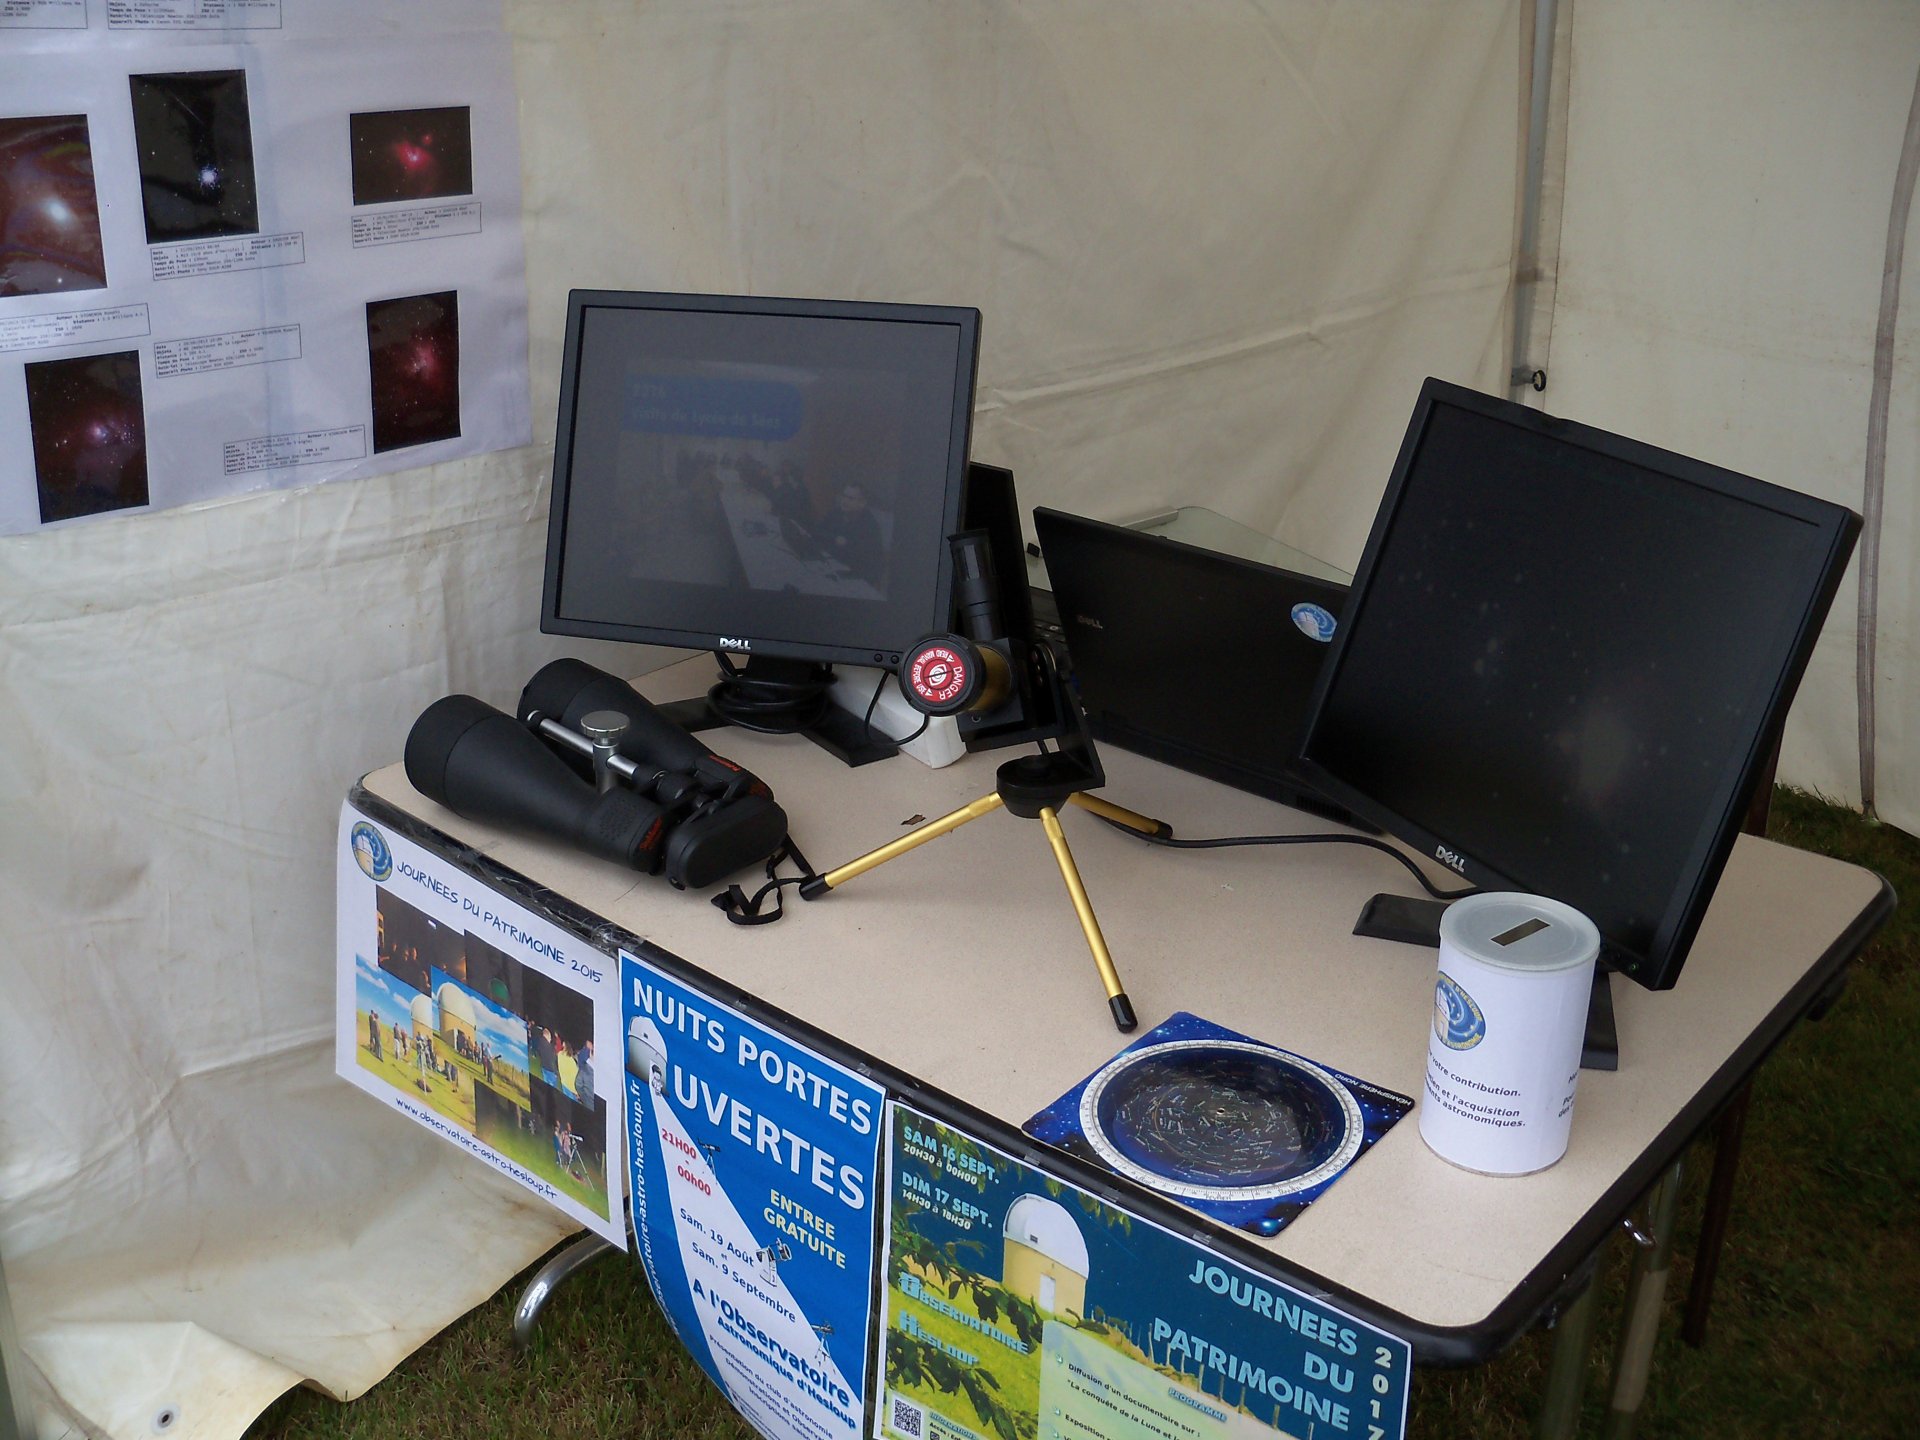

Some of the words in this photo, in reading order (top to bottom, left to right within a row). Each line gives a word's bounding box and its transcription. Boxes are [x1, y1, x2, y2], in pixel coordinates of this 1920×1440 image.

[720, 637, 751, 650] DELL
[938, 665, 964, 700] DANGER
[1435, 845, 1465, 873] DELL
[396, 861, 459, 904] JOURNEES
[463, 899, 480, 916] DU
[484, 911, 565, 965] PATRIMOINE
[571, 959, 604, 983] 2015
[633, 977, 726, 1054] NUITS
[738, 1034, 872, 1136] PORTES
[1441, 1089, 1451, 1099] et
[1452, 1094, 1520, 1118] l'acquisition
[1450, 1072, 1521, 1097] contribution.
[673, 1064, 866, 1211] UVERTES
[1442, 1101, 1526, 1128] astronomiques.
[661, 1128, 697, 1160] 21H00
[903, 1125, 938, 1153] SAM
[941, 1142, 956, 1162] 16
[959, 1153, 1000, 1185] SEPT.
[903, 1142, 936, 1164] 20H30
[936, 1156, 943, 1168] à
[946, 1163, 978, 1186] 00H00
[677, 1166, 712, 1197] 00h00
[902, 1171, 931, 1197] DIM
[935, 1187, 950, 1205] 17
[952, 1197, 993, 1229] SEPT.
[770, 1188, 836, 1241] ENTREE
[902, 1189, 931, 1210] 14H30
[932, 1203, 939, 1214] à
[942, 1208, 972, 1231] 18H30
[680, 1207, 707, 1235] Sam.
[710, 1229, 724, 1246] 19
[726, 1243, 755, 1268] Août
[763, 1207, 847, 1270] GRATUITE
[692, 1242, 719, 1269] Sam.
[721, 1263, 729, 1275] 9
[732, 1270, 796, 1323] Septembre
[1188, 1258, 1358, 1356] JOURNEES
[692, 1278, 706, 1301] A
[710, 1289, 850, 1408] l'Observatoire
[717, 1316, 794, 1383] Astronomique
[797, 1377, 857, 1430] d'Hesloup
[1068, 1362, 1104, 1388] Diffusion
[1104, 1382, 1122, 1397] d'un
[1123, 1393, 1180, 1428] documentaire
[1181, 1422, 1196, 1435] sur
[1153, 1317, 1351, 1432] PATRIMOINE
[1303, 1350, 1355, 1394] DU
[1065, 1413, 1106, 1440] Exposition
[1081, 1387, 1118, 1412] conquête
[1119, 1407, 1130, 1419] de
[1130, 1411, 1139, 1423] la
[1141, 1417, 1162, 1435] Lune
[1162, 1428, 1173, 1440] et
[1168, 1386, 1228, 1423] PROGRAMME
